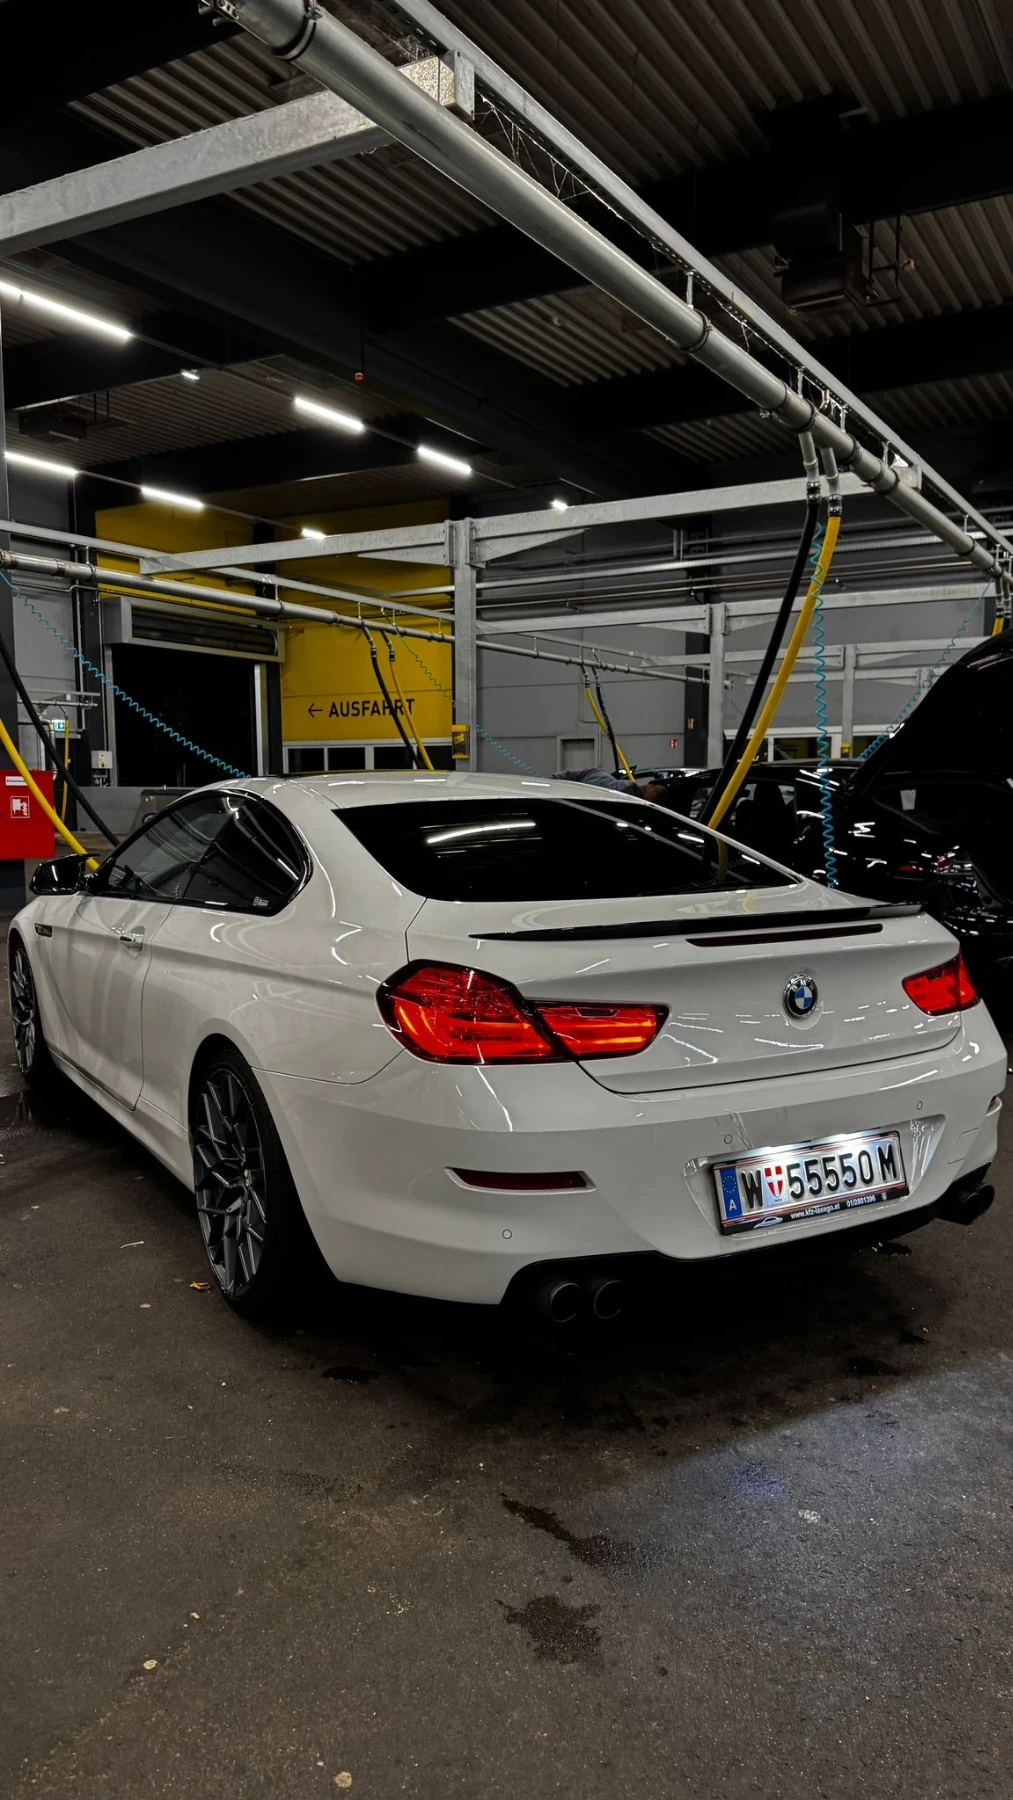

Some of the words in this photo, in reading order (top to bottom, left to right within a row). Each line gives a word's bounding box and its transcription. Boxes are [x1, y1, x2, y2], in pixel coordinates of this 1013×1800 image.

[329, 699, 415, 718] AUSFAHRT
[741, 1168, 764, 1210] W
[729, 1200, 738, 1212] A
